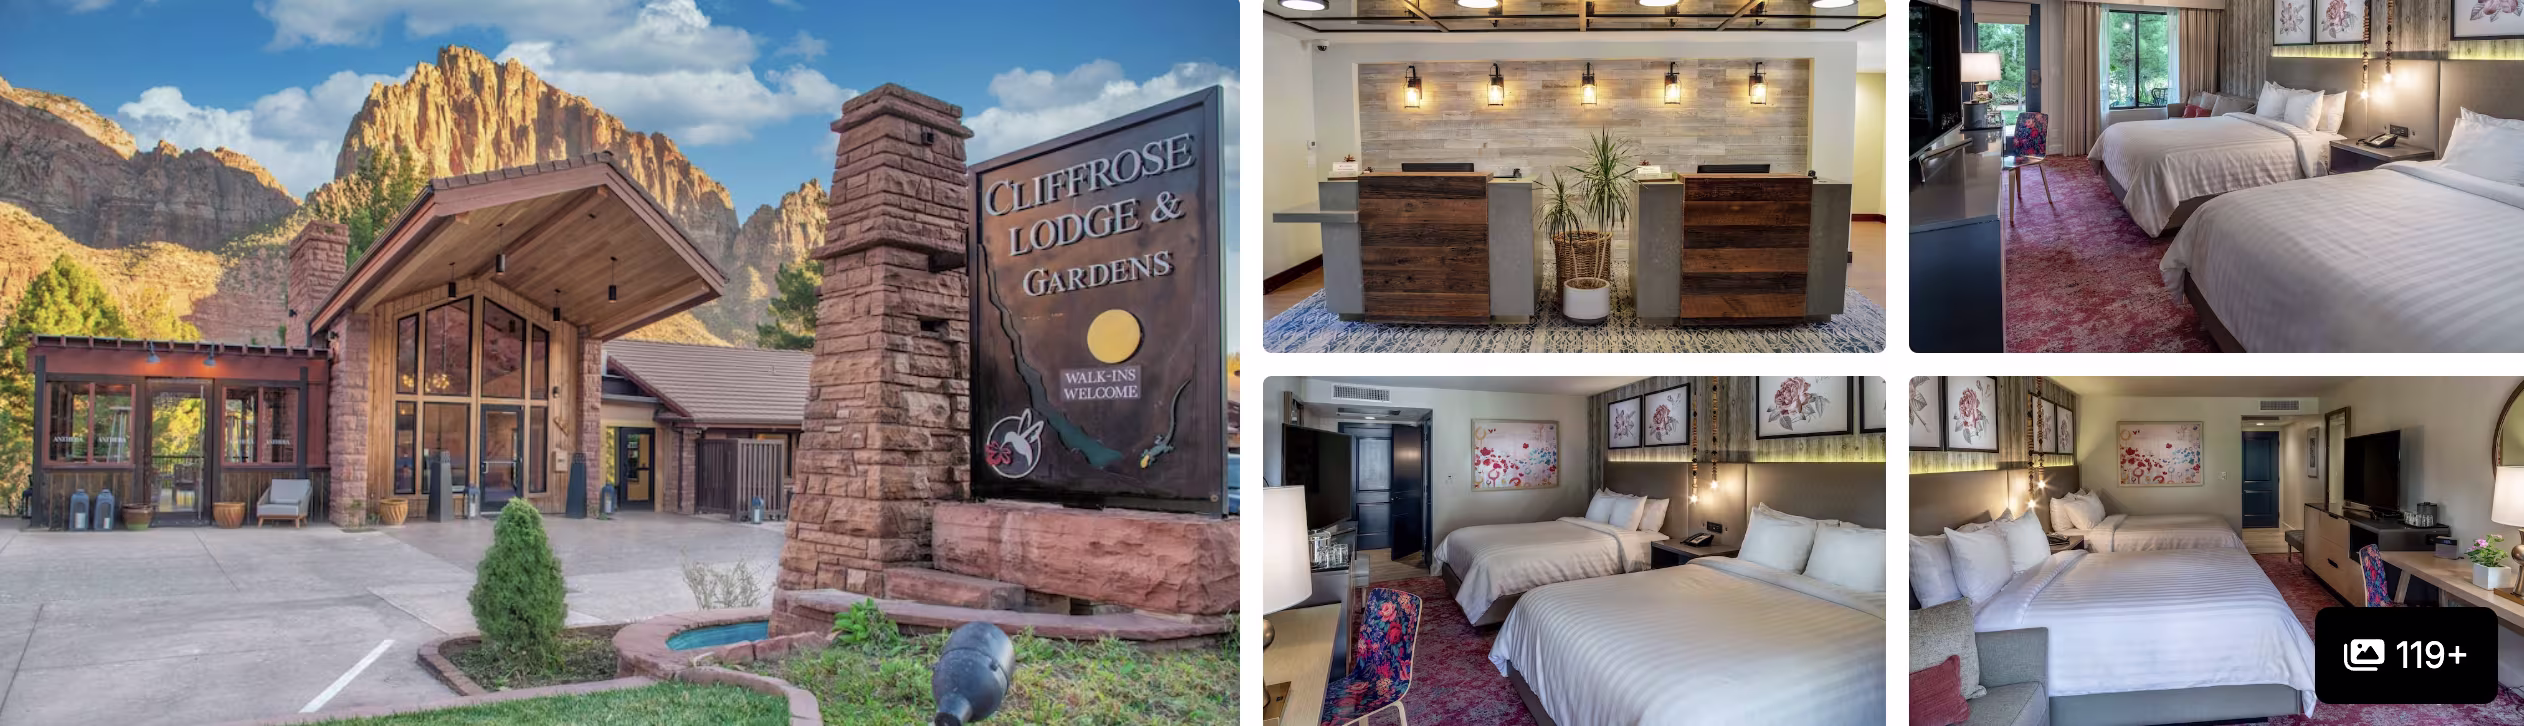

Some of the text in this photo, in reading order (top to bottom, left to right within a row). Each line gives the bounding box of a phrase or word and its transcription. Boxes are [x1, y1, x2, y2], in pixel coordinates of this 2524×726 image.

[985, 133, 1195, 217] CLIFFROSE
[1009, 191, 1184, 257] LODGE &
[1023, 250, 1173, 297] GARDENS
[1063, 385, 1138, 400] WELCOME
[1065, 369, 1136, 384] WALK-INS
